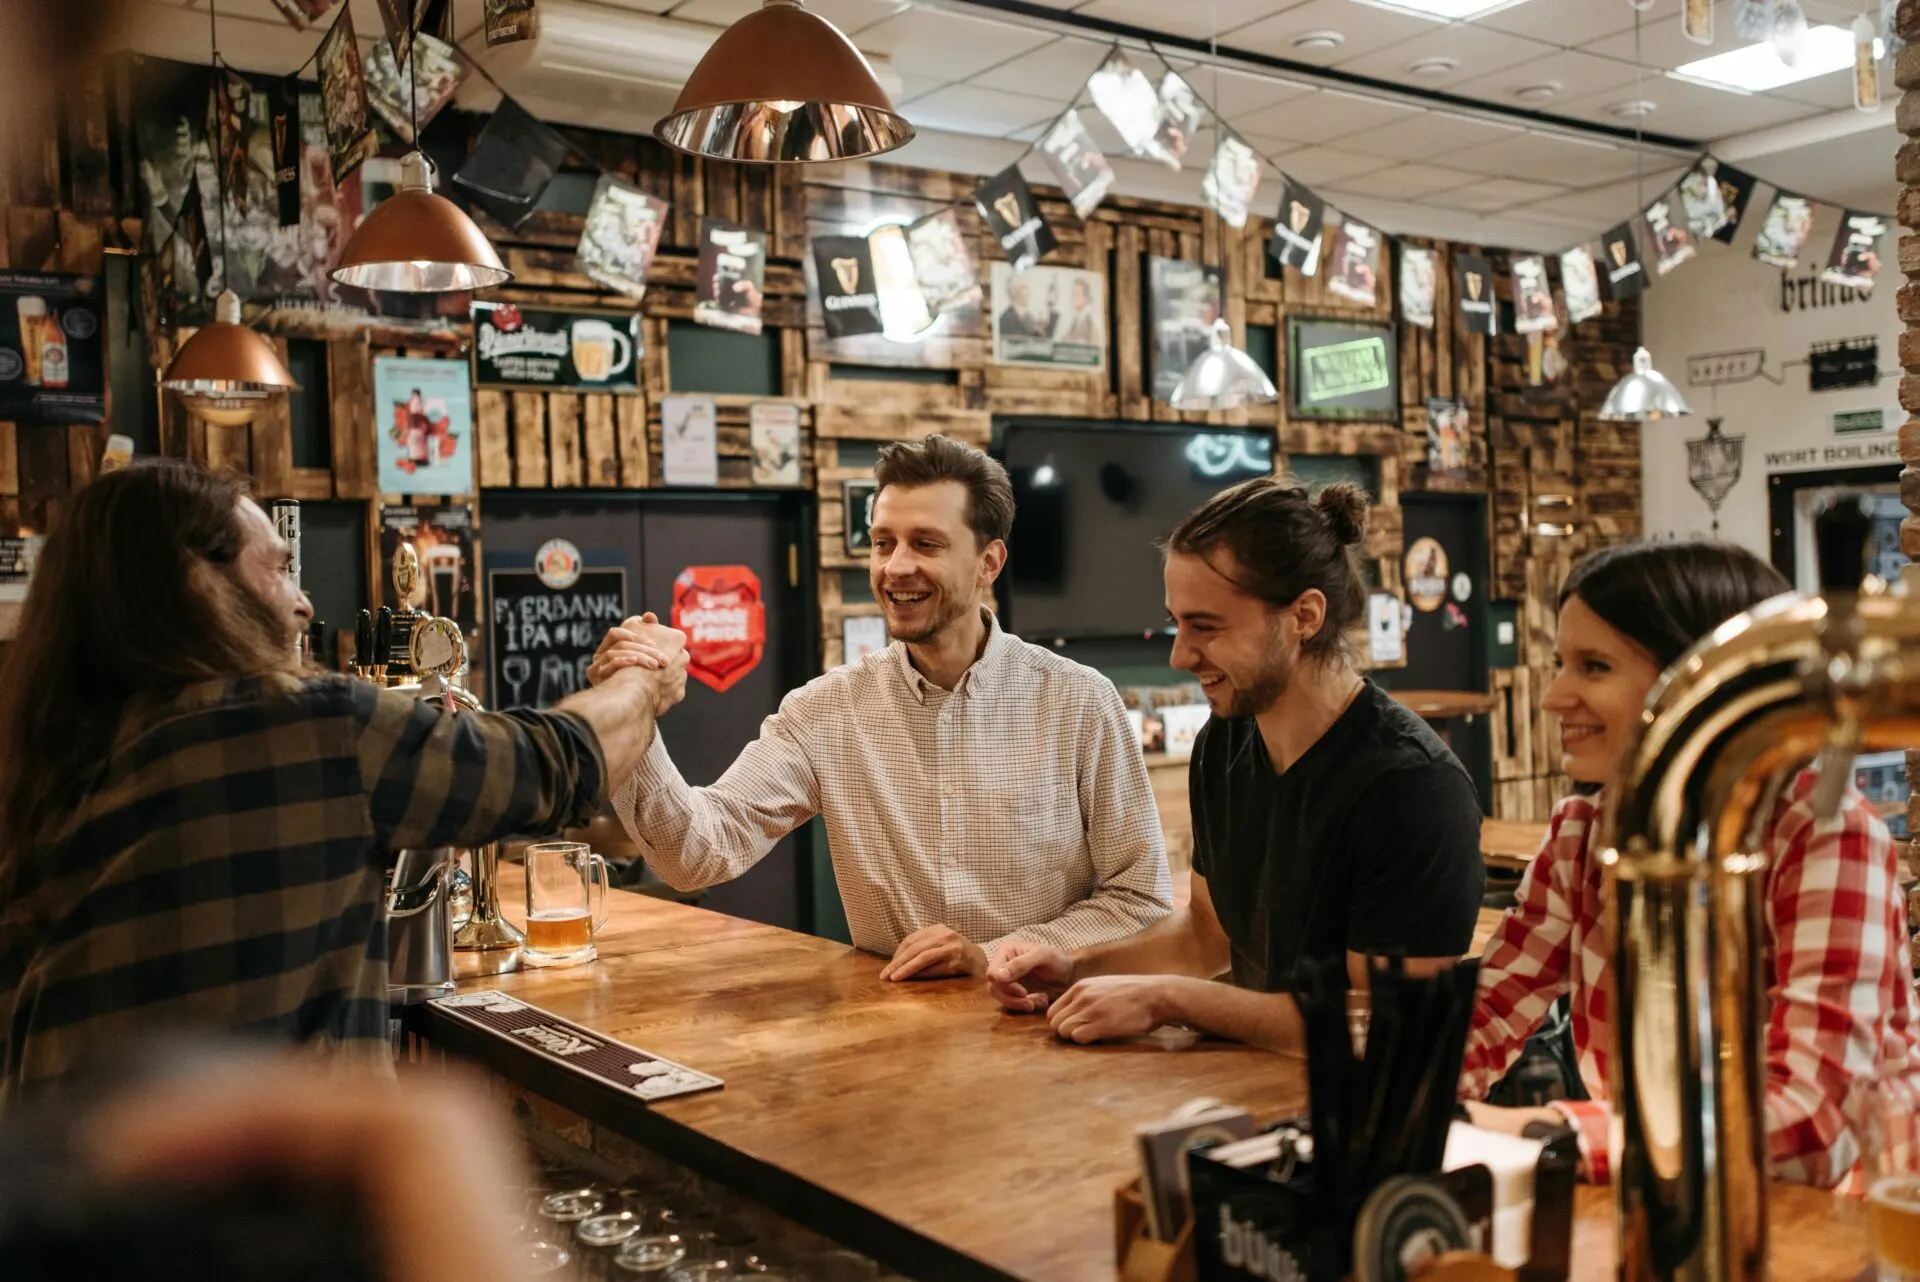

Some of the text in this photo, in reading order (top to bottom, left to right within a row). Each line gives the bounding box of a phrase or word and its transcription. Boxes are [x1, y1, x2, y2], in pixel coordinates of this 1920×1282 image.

[1765, 442, 1899, 466] WORT BOILING
[505, 622, 552, 651] IPA
